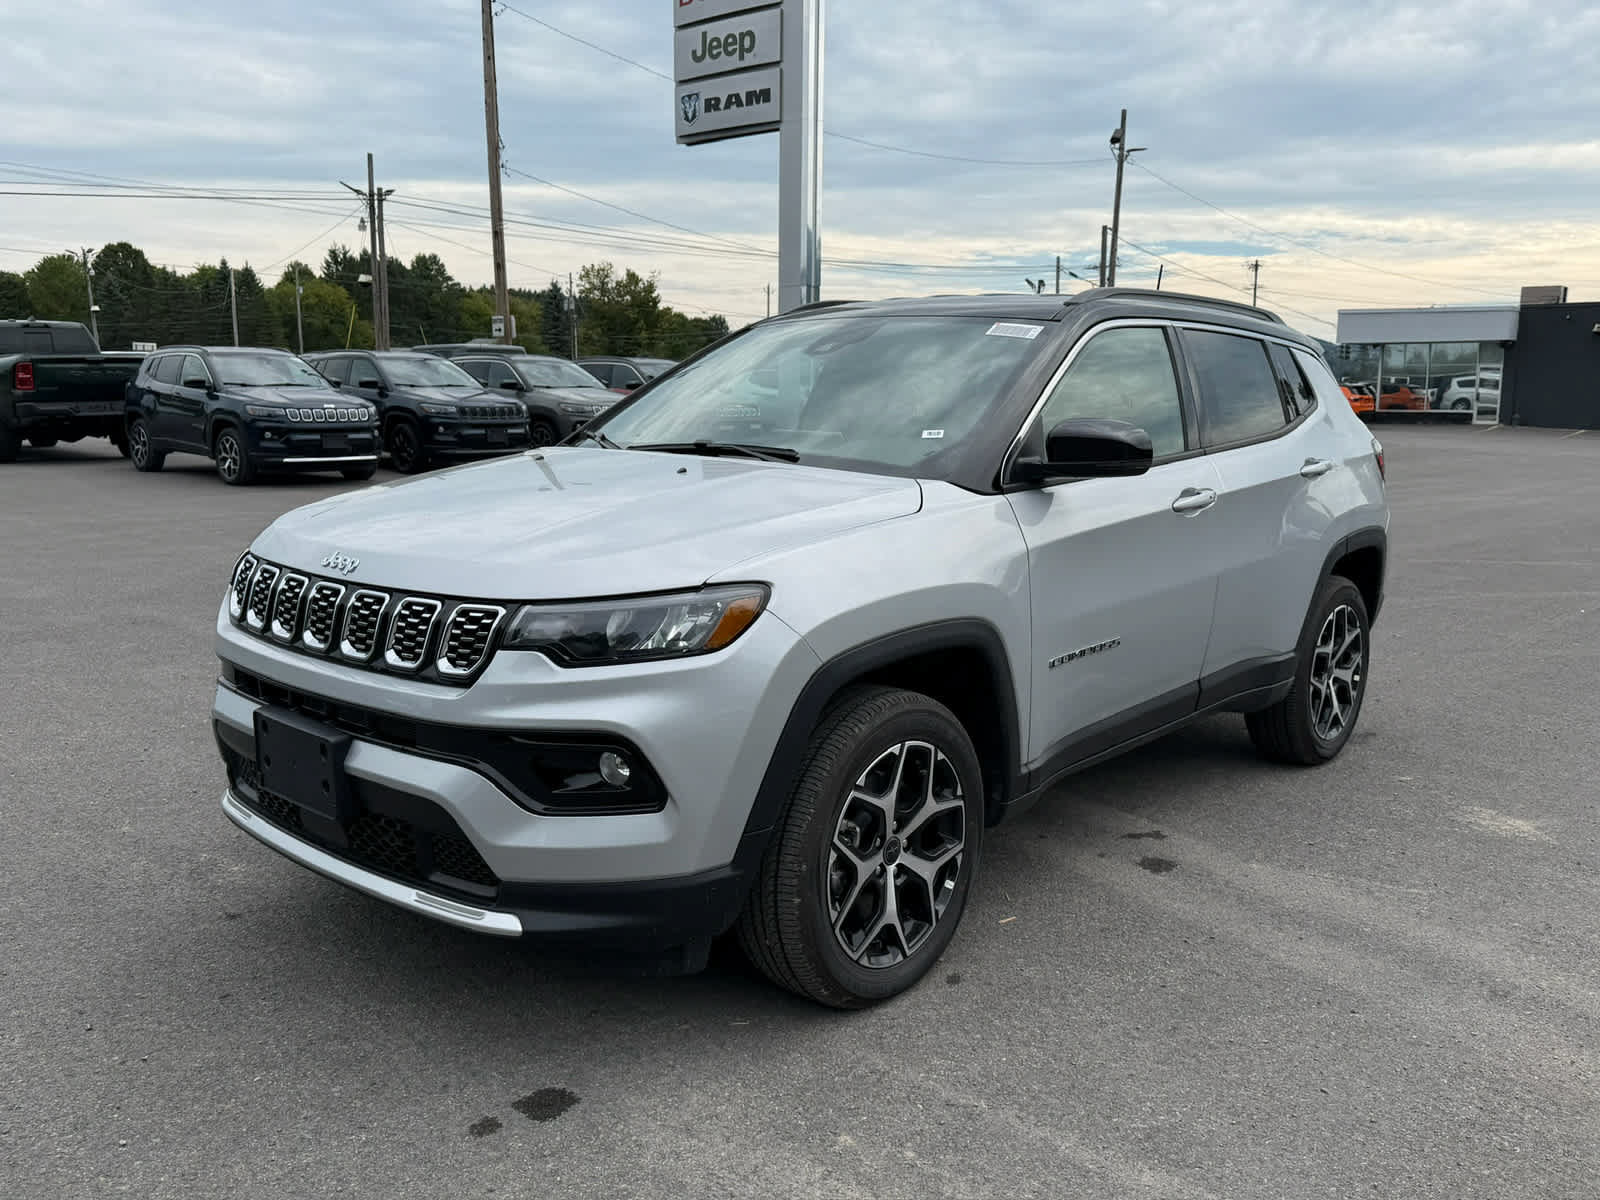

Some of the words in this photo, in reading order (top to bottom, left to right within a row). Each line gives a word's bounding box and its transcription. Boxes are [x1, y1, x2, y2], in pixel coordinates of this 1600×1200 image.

[692, 29, 756, 63] Jeep
[704, 88, 771, 113] RAM
[321, 551, 360, 576] Jeep
[1048, 636, 1121, 669] COMPASS
